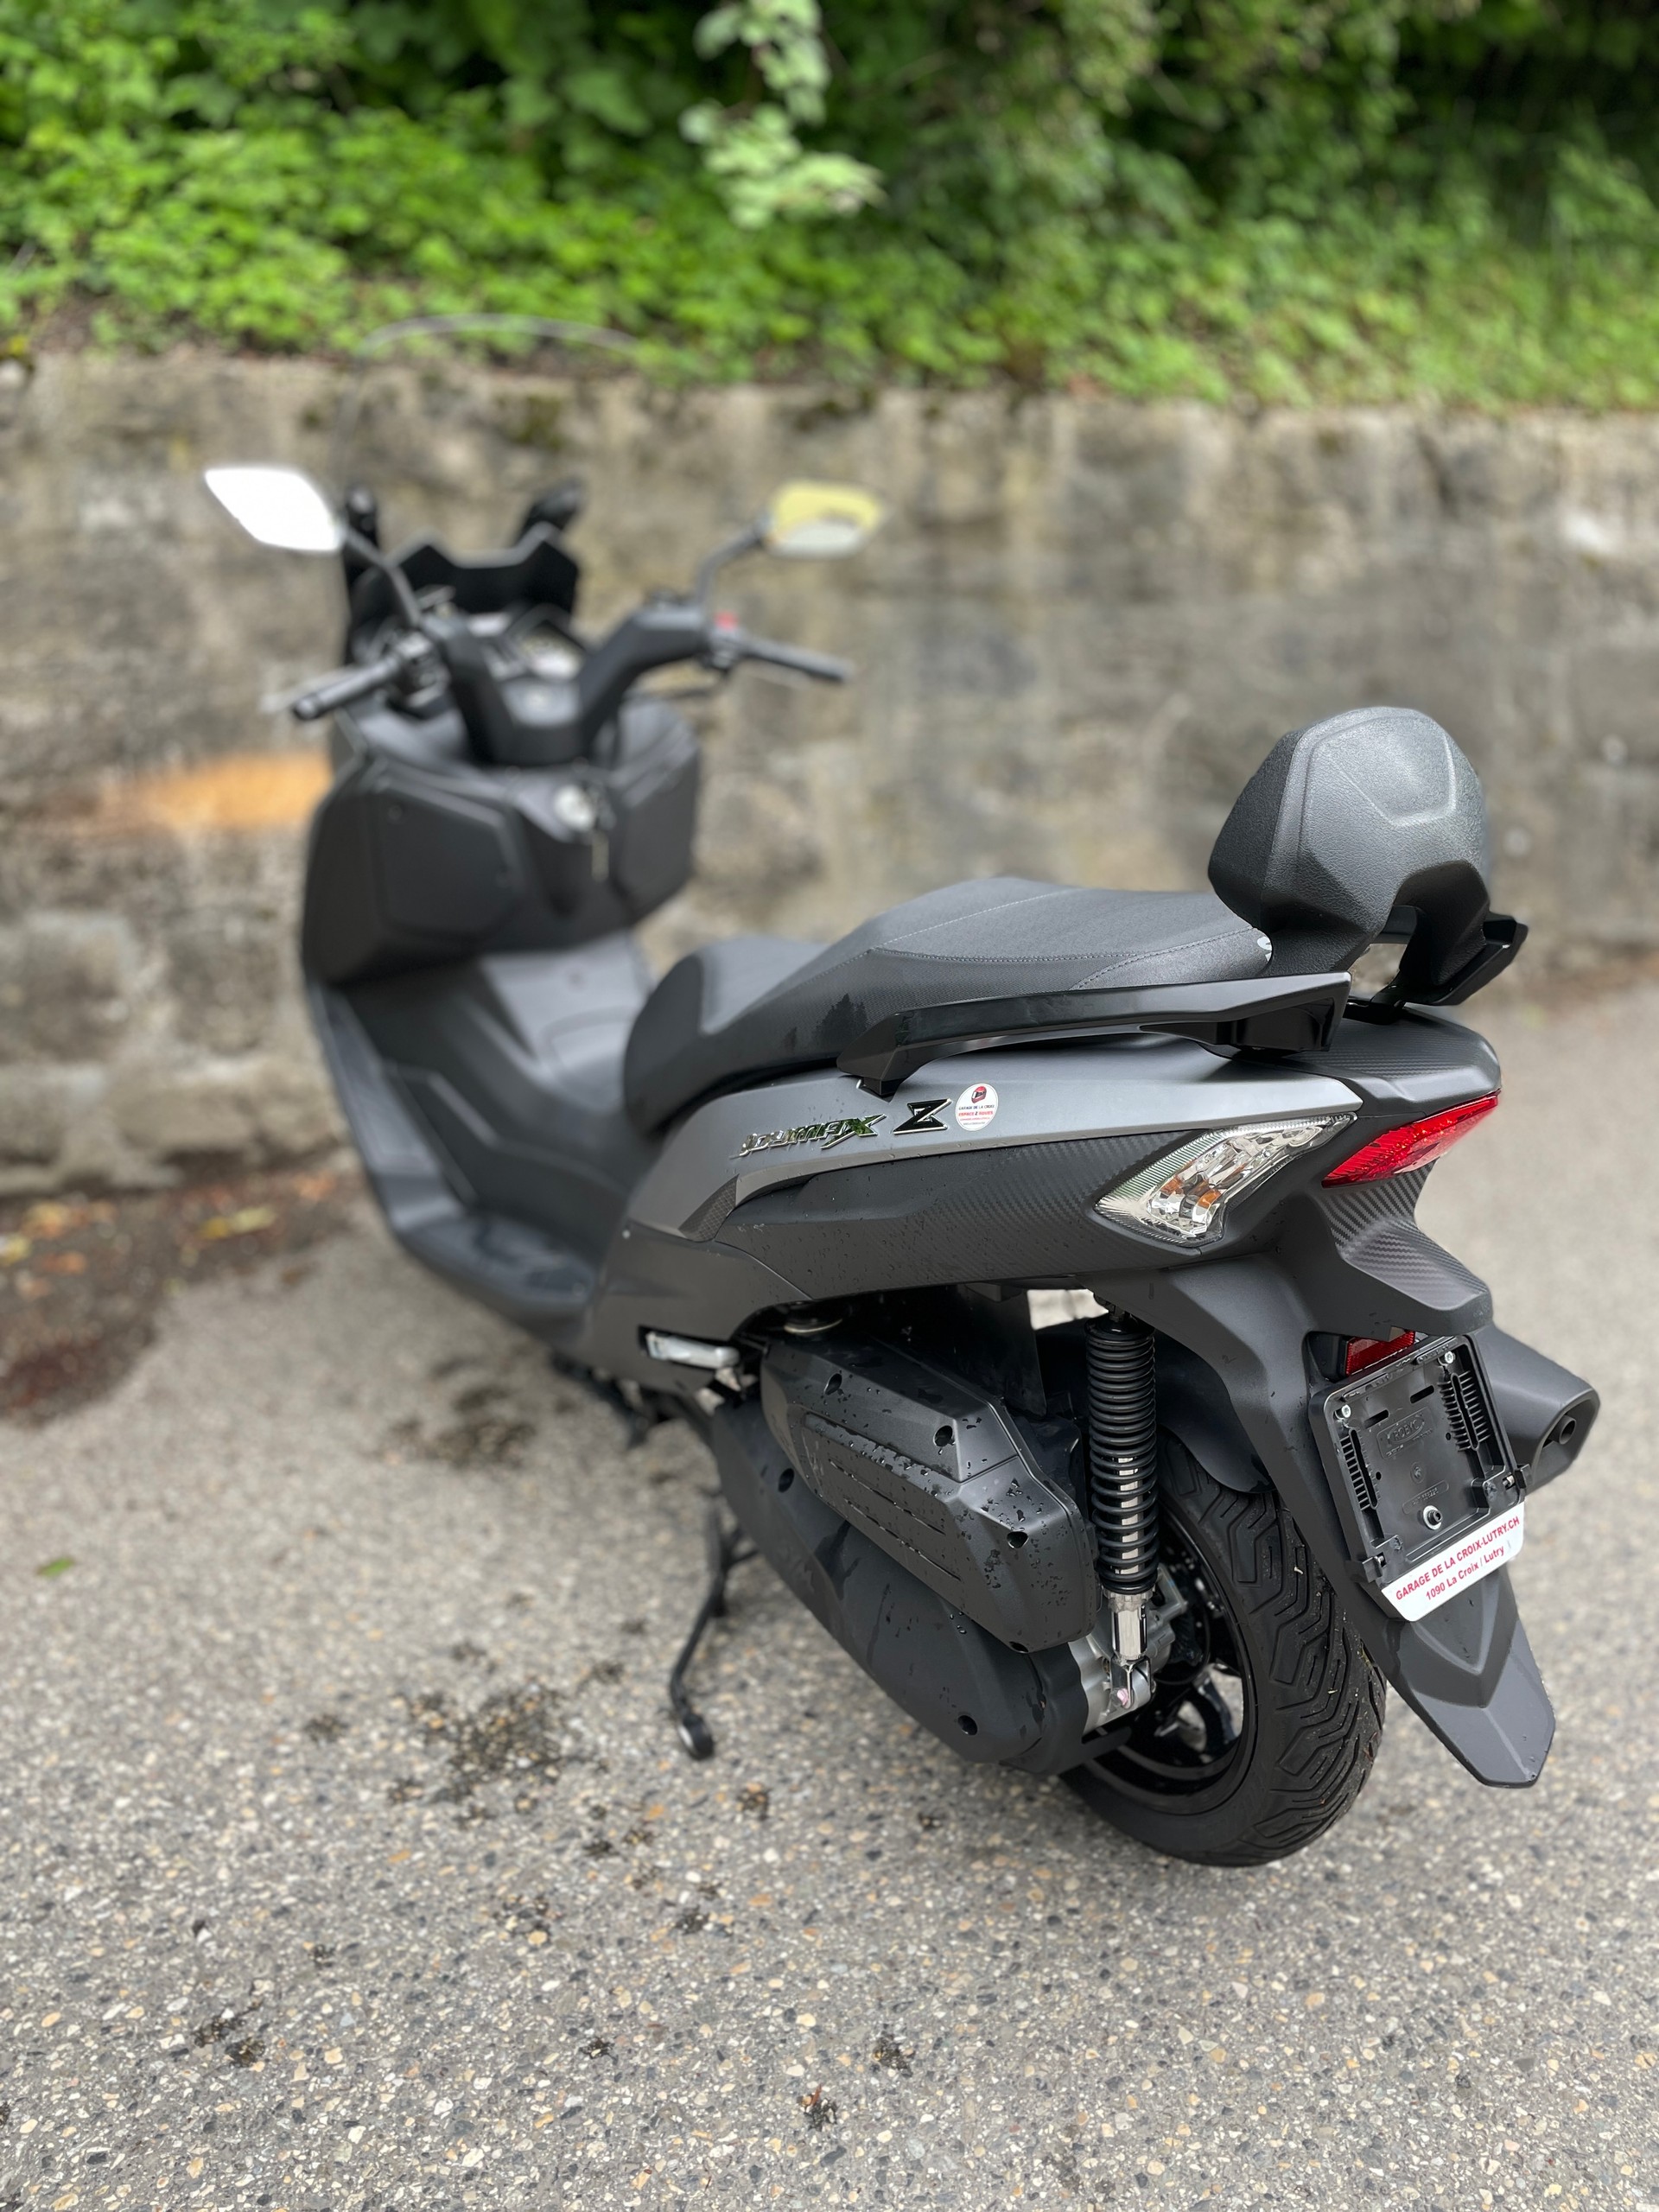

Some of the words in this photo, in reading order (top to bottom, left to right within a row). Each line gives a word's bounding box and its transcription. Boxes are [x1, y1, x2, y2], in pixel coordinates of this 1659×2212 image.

[893, 1097, 953, 1135] Z
[1396, 1573, 1431, 1600] GARAGE
[1432, 1565, 1443, 1577] DE
[1445, 1558, 1456, 1569] LA
[1457, 1516, 1520, 1560] CROIX-LUTRY.CH
[1426, 1583, 1446, 1600] 1090
[1446, 1576, 1457, 1587] La
[1459, 1563, 1478, 1580] Croix
[1484, 1546, 1504, 1563] Lutry
